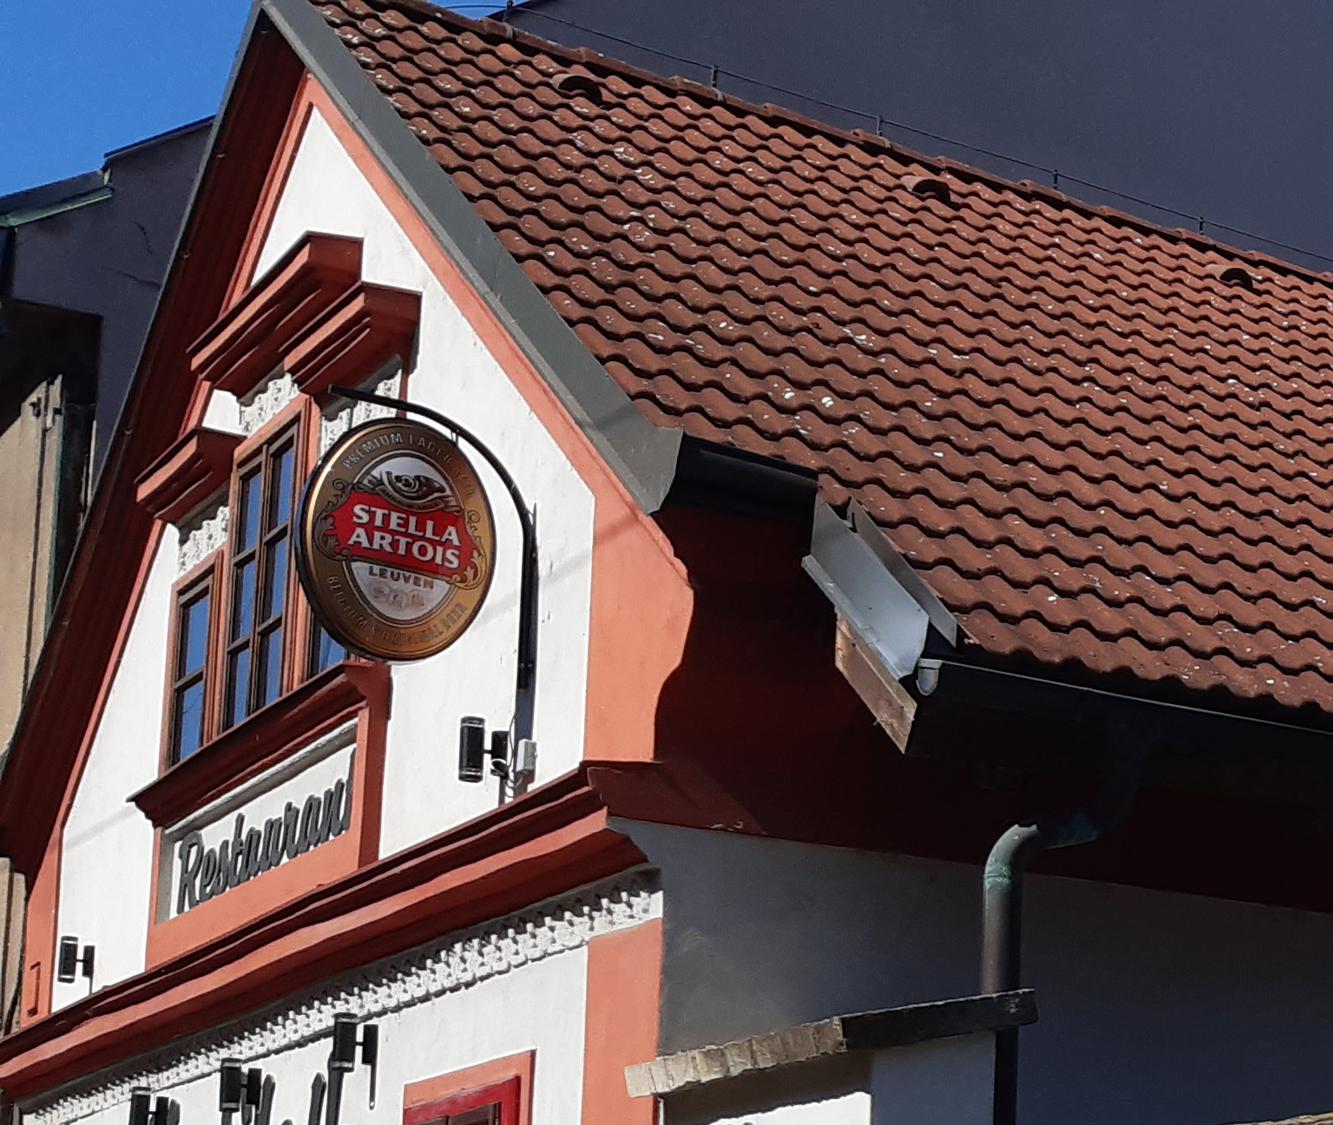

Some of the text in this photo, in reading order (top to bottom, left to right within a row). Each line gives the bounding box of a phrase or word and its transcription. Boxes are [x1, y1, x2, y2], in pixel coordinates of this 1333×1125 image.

[352, 503, 462, 547] STELLA
[347, 527, 461, 569] ARTOIS
[368, 565, 434, 590] LEUVEN
